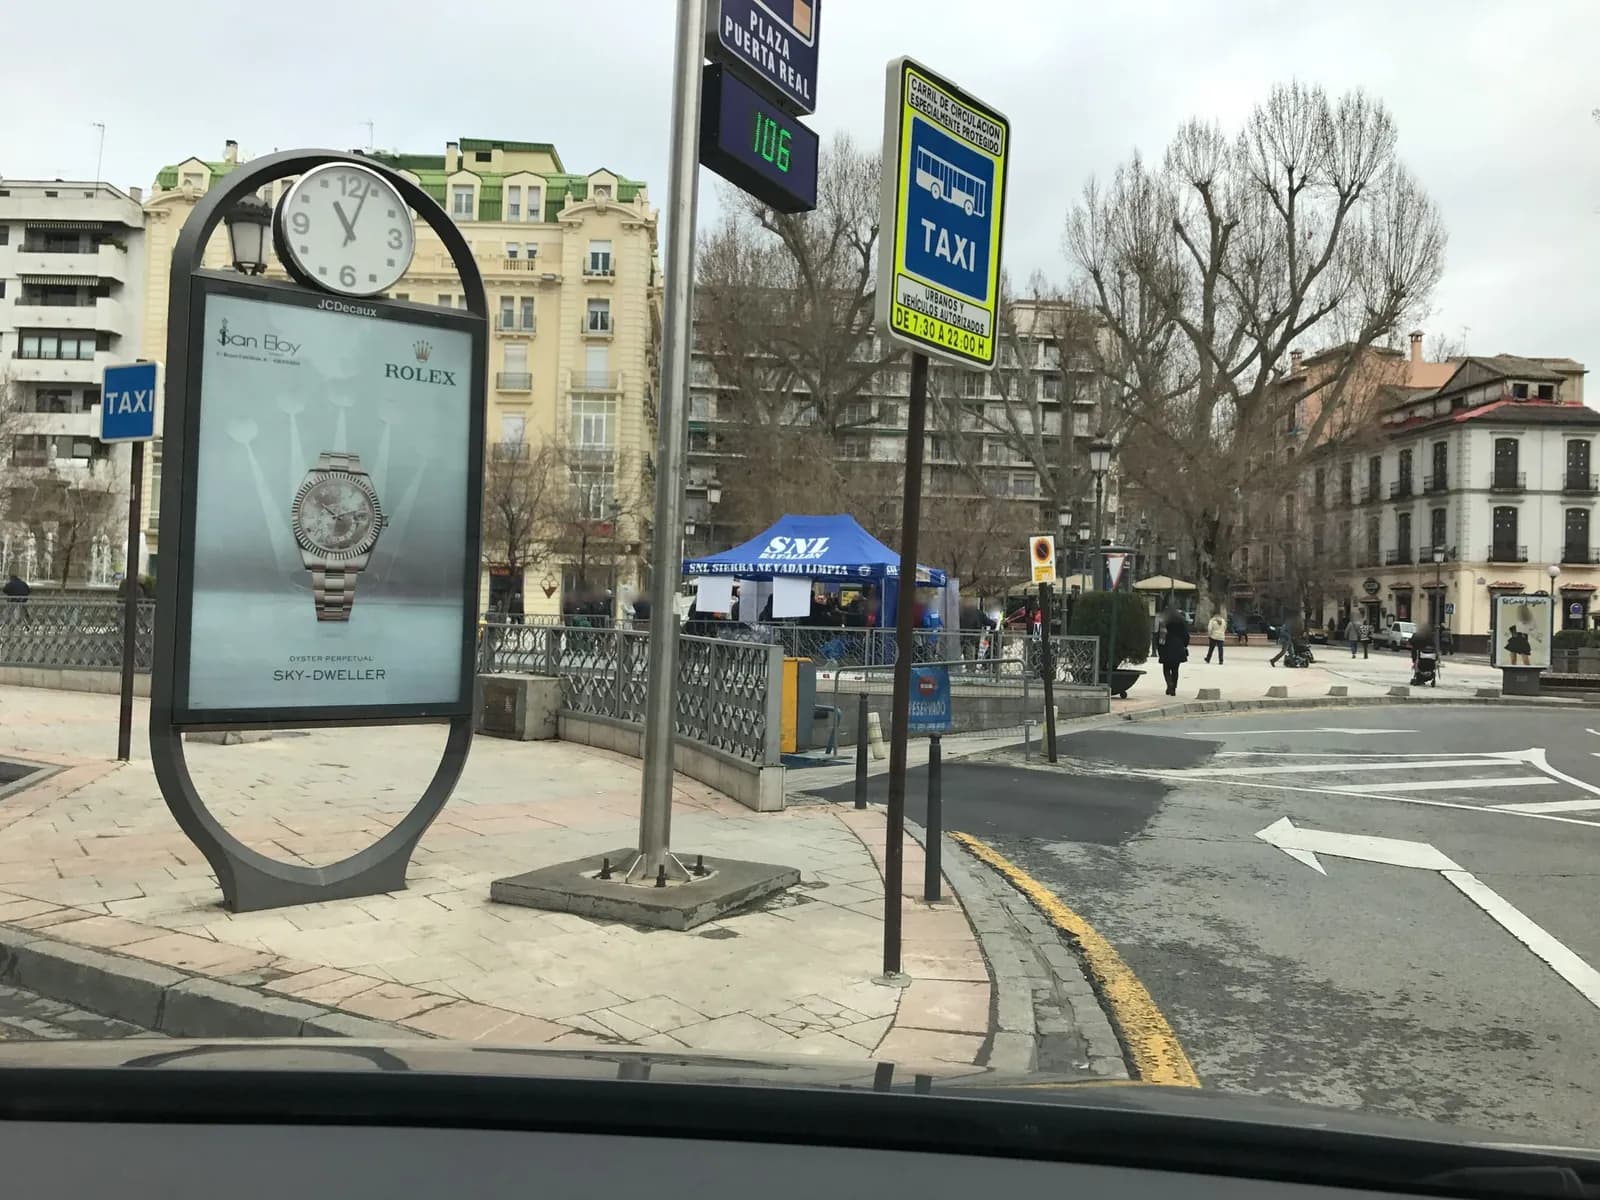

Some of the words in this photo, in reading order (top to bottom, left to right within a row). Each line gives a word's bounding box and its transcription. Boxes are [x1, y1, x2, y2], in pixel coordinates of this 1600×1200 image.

[750, 9, 790, 60] PLAZA
[725, 15, 776, 74] PUERTA
[779, 59, 810, 100] REAL
[911, 78, 938, 104] CARRIL
[940, 96, 949, 111] DE
[950, 103, 1000, 140] CIRCULACION
[910, 92, 960, 133] ESPECIALMENTE
[962, 125, 999, 152] PROTEGIDO
[754, 111, 792, 173] 106
[336, 175, 364, 199] 12
[291, 212, 310, 235] 9
[387, 228, 403, 250] 3
[921, 217, 976, 273] TAXI
[339, 265, 356, 288] 6
[317, 299, 377, 317] JCDecaux
[925, 288, 958, 312] URBANOS
[960, 302, 965, 314] Y
[902, 292, 938, 318] VEHÍCULOS
[940, 308, 985, 335] AUTORIZADOS
[896, 307, 910, 330] DE
[913, 315, 935, 339] 7:30
[938, 324, 945, 343] A
[947, 328, 976, 353] 22:00
[264, 333, 302, 356] Eloy
[384, 363, 457, 386] ROLEX
[106, 389, 154, 415] TAXI
[764, 536, 830, 554] SNL
[689, 563, 710, 573] SNL
[712, 563, 753, 573] SIERRA
[757, 563, 803, 574] NEVADA
[806, 564, 848, 575] LIMPIA
[272, 669, 386, 682] SKY-DWELLER
[908, 701, 946, 716] ESERVADO
